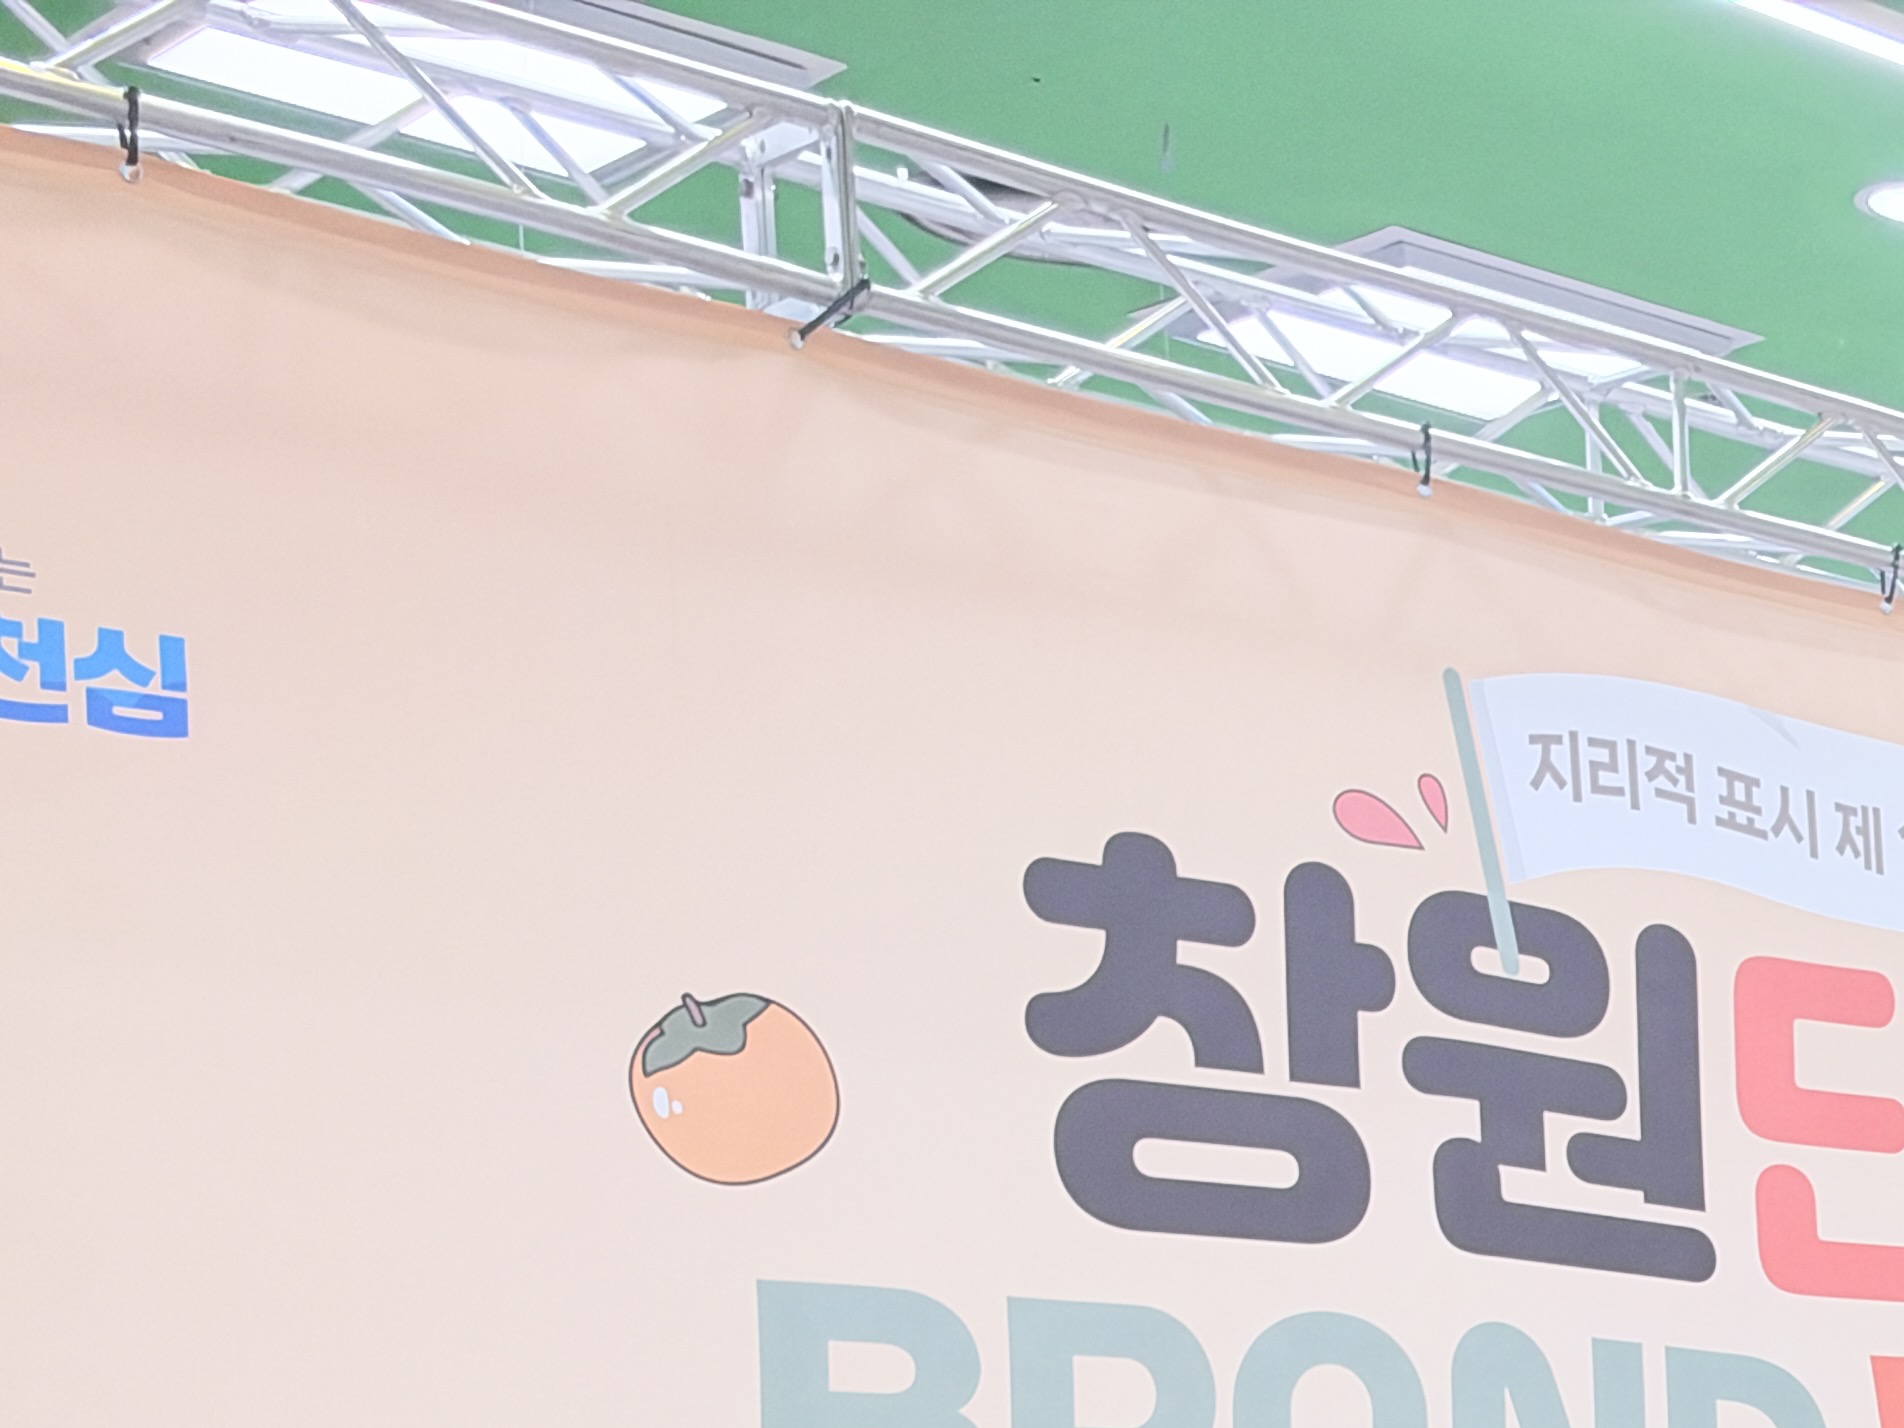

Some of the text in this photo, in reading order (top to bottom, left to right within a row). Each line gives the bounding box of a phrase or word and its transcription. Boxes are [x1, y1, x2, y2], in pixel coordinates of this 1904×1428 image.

[1526, 729, 1699, 825] 지리적
[1713, 764, 1822, 860] 표시
[1833, 802, 1887, 876] 제
